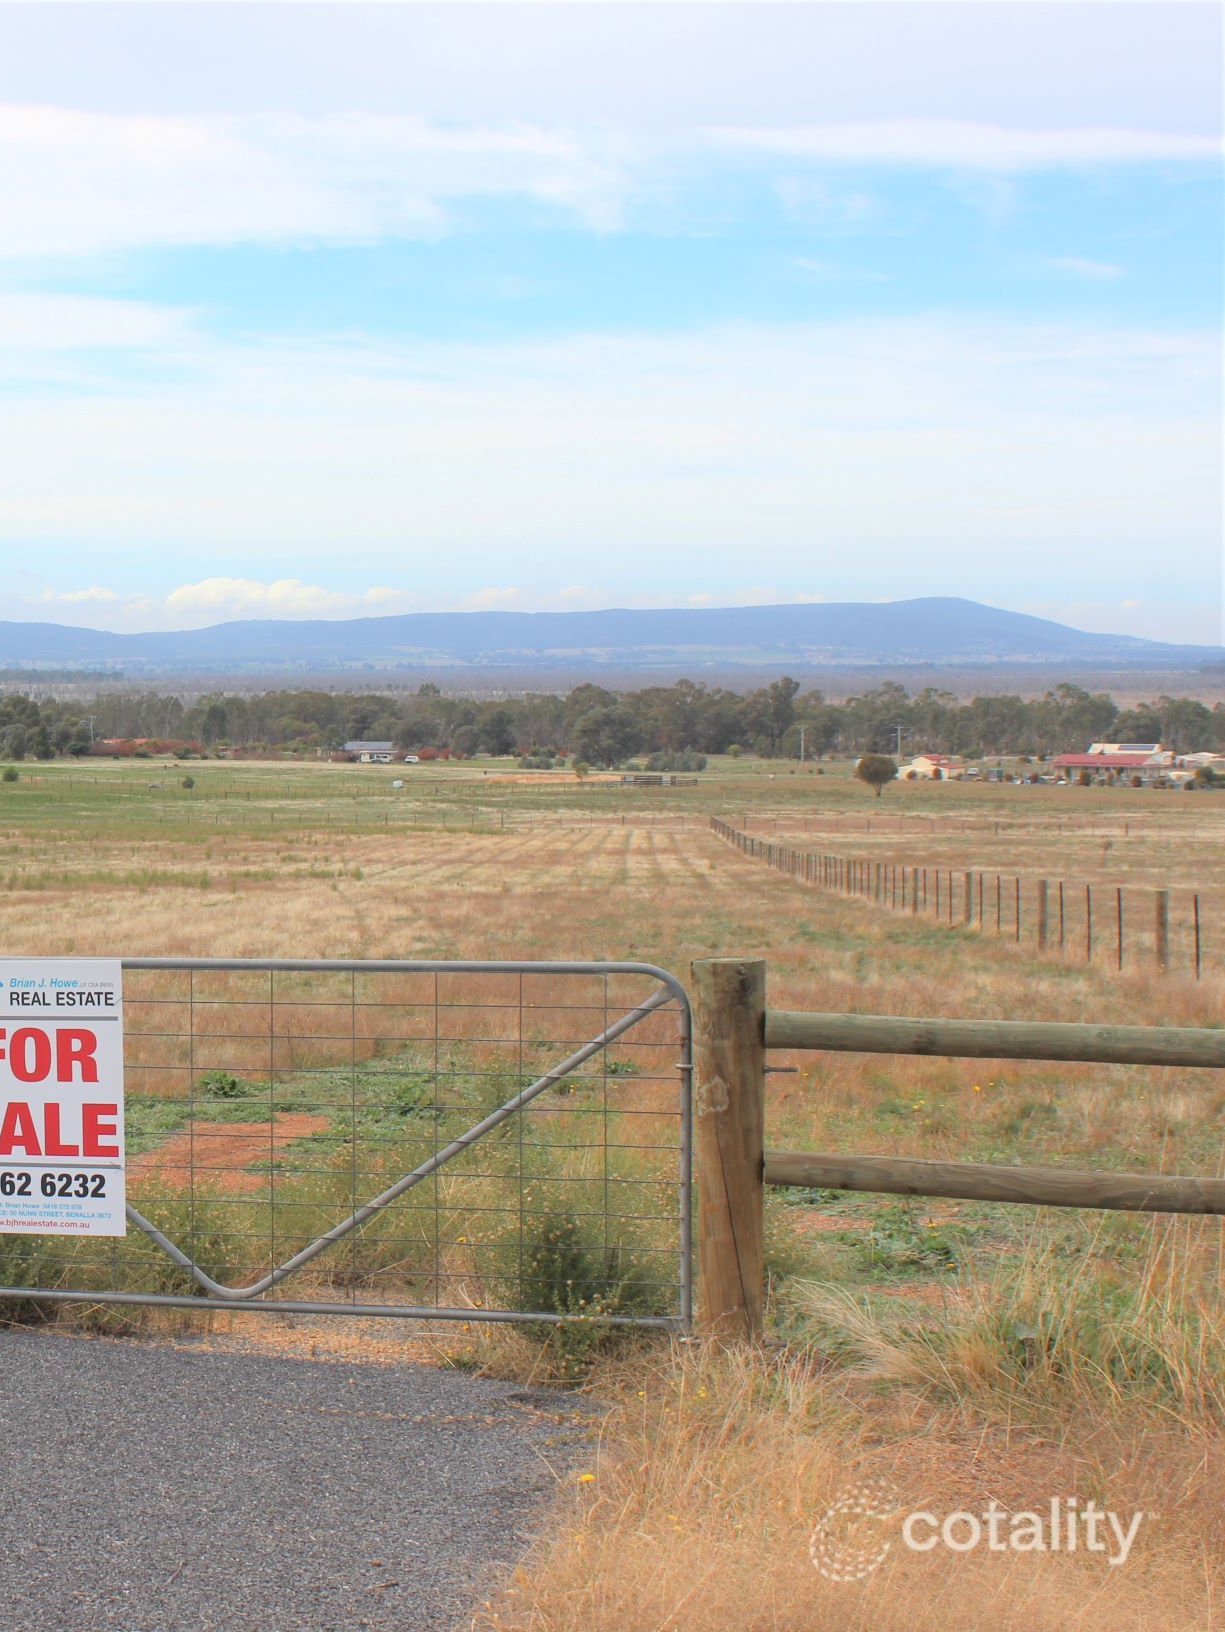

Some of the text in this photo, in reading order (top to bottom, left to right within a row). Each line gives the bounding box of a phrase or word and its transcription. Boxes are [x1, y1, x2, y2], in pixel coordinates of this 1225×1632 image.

[9, 978, 36, 988] Brian
[38, 978, 47, 988] J.
[49, 978, 78, 988] Howe
[9, 992, 114, 1006] REAL ESTATE
[40, 1172, 106, 1198] 6232
